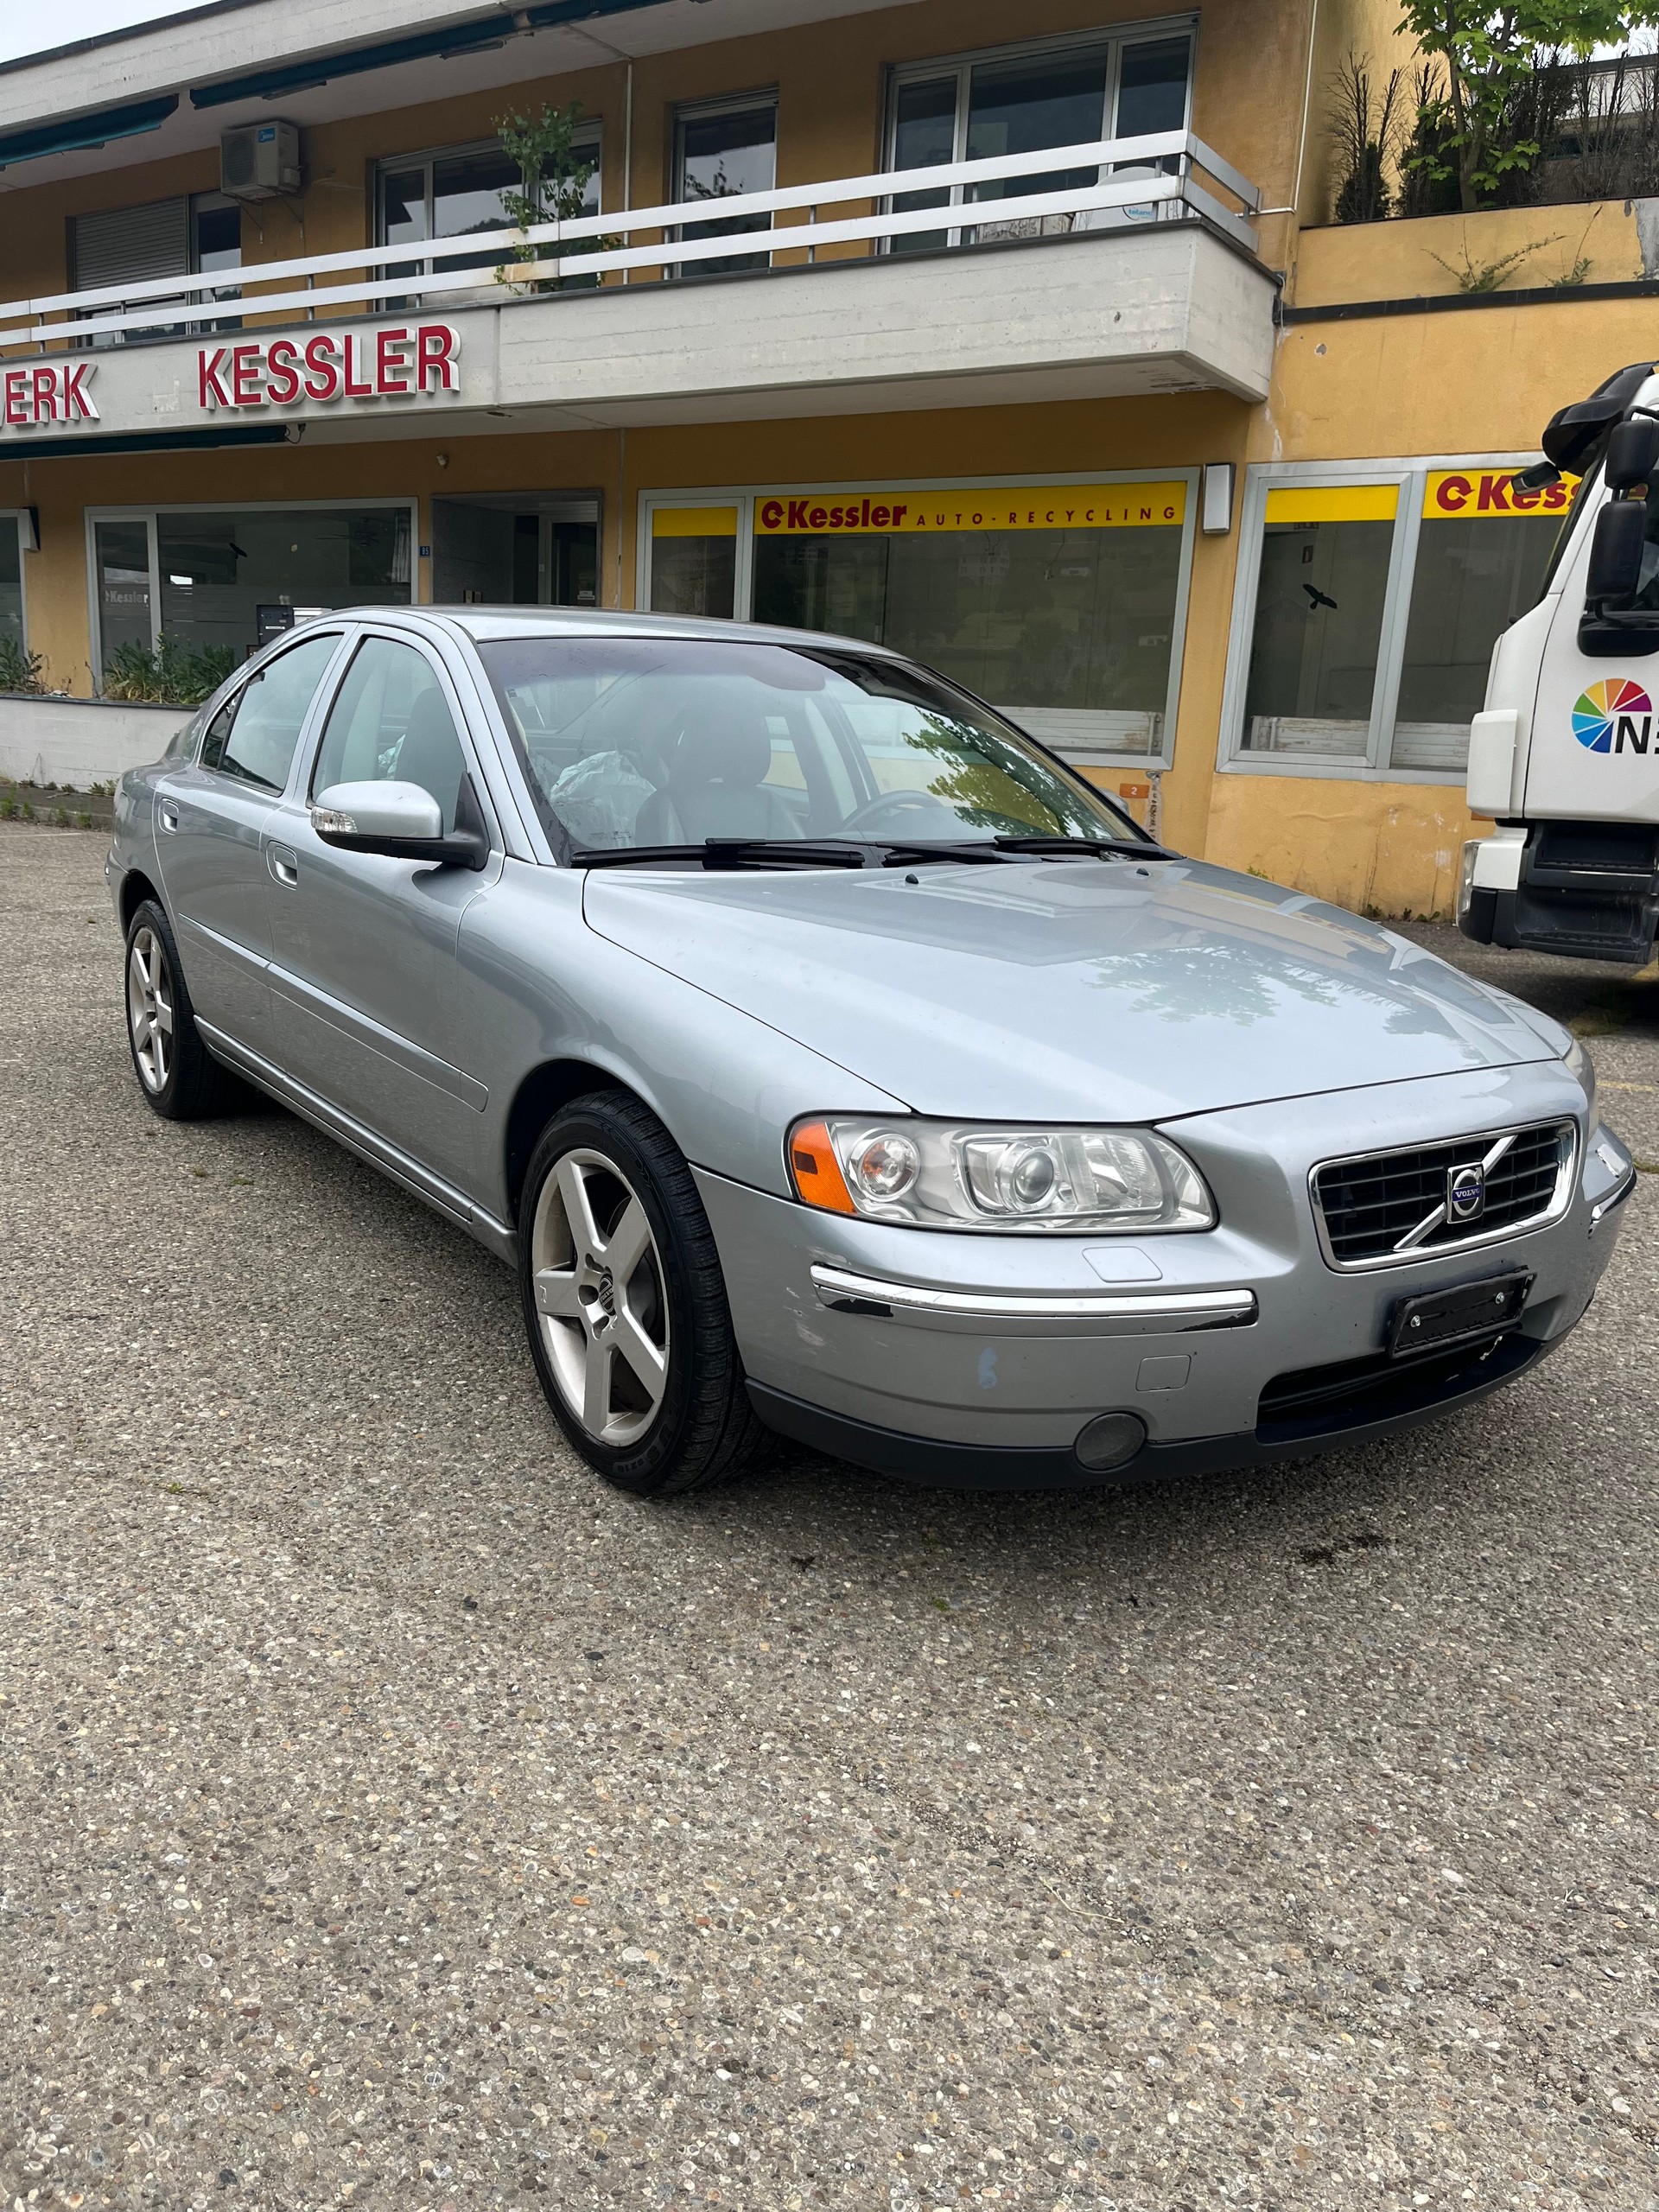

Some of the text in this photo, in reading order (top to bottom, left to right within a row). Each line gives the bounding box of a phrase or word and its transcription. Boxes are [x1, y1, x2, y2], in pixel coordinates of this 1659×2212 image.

[198, 324, 457, 409] KESSLER
[787, 499, 907, 529] Kessler
[1131, 786, 1138, 796] 2
[1455, 1188, 1480, 1198] VOLVO
